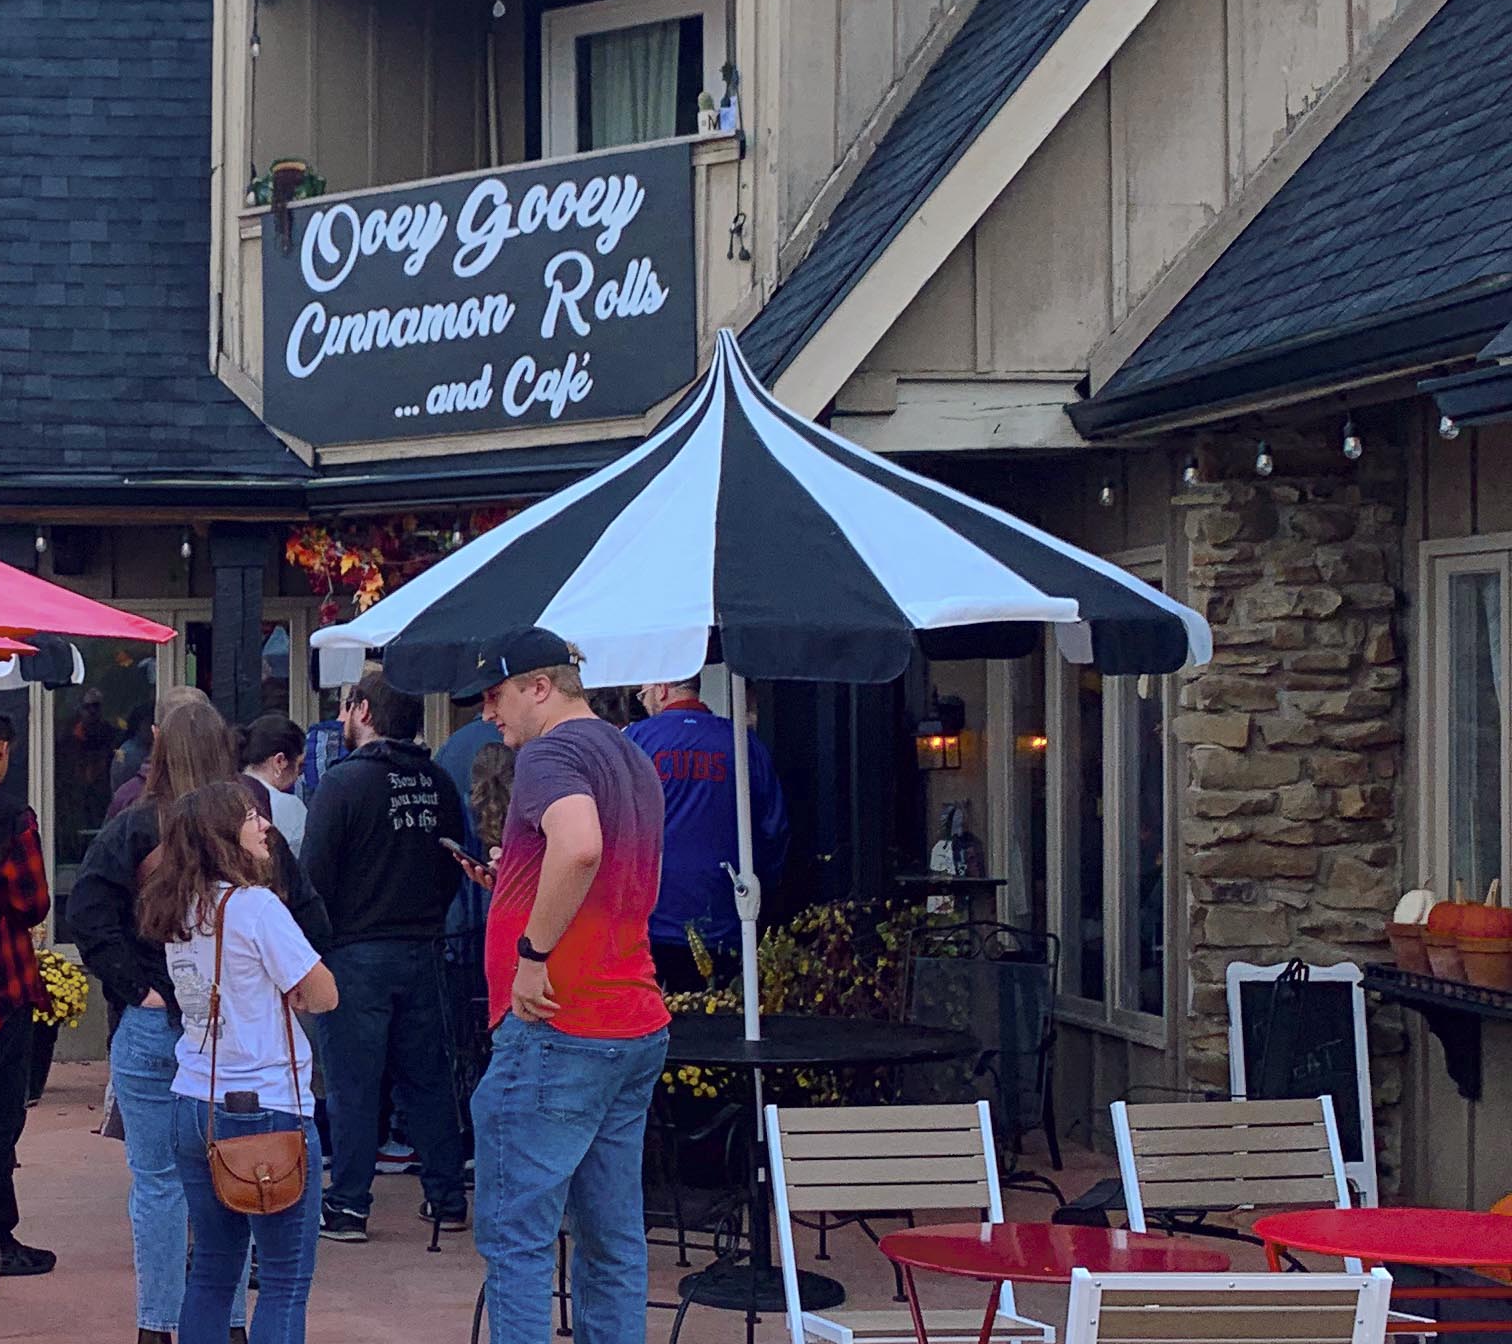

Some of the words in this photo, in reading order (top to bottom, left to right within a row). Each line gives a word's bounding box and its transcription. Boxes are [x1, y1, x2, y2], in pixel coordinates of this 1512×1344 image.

[301, 201, 448, 293] Ooey
[453, 174, 645, 278] Gooey
[286, 292, 515, 378] Cinnamon
[541, 250, 669, 339] Rolls
[502, 353, 593, 419] Café
[388, 772, 417, 789] How
[419, 771, 433, 787] do
[654, 749, 728, 783] CUBS
[389, 794, 411, 816] you
[412, 792, 439, 805] want
